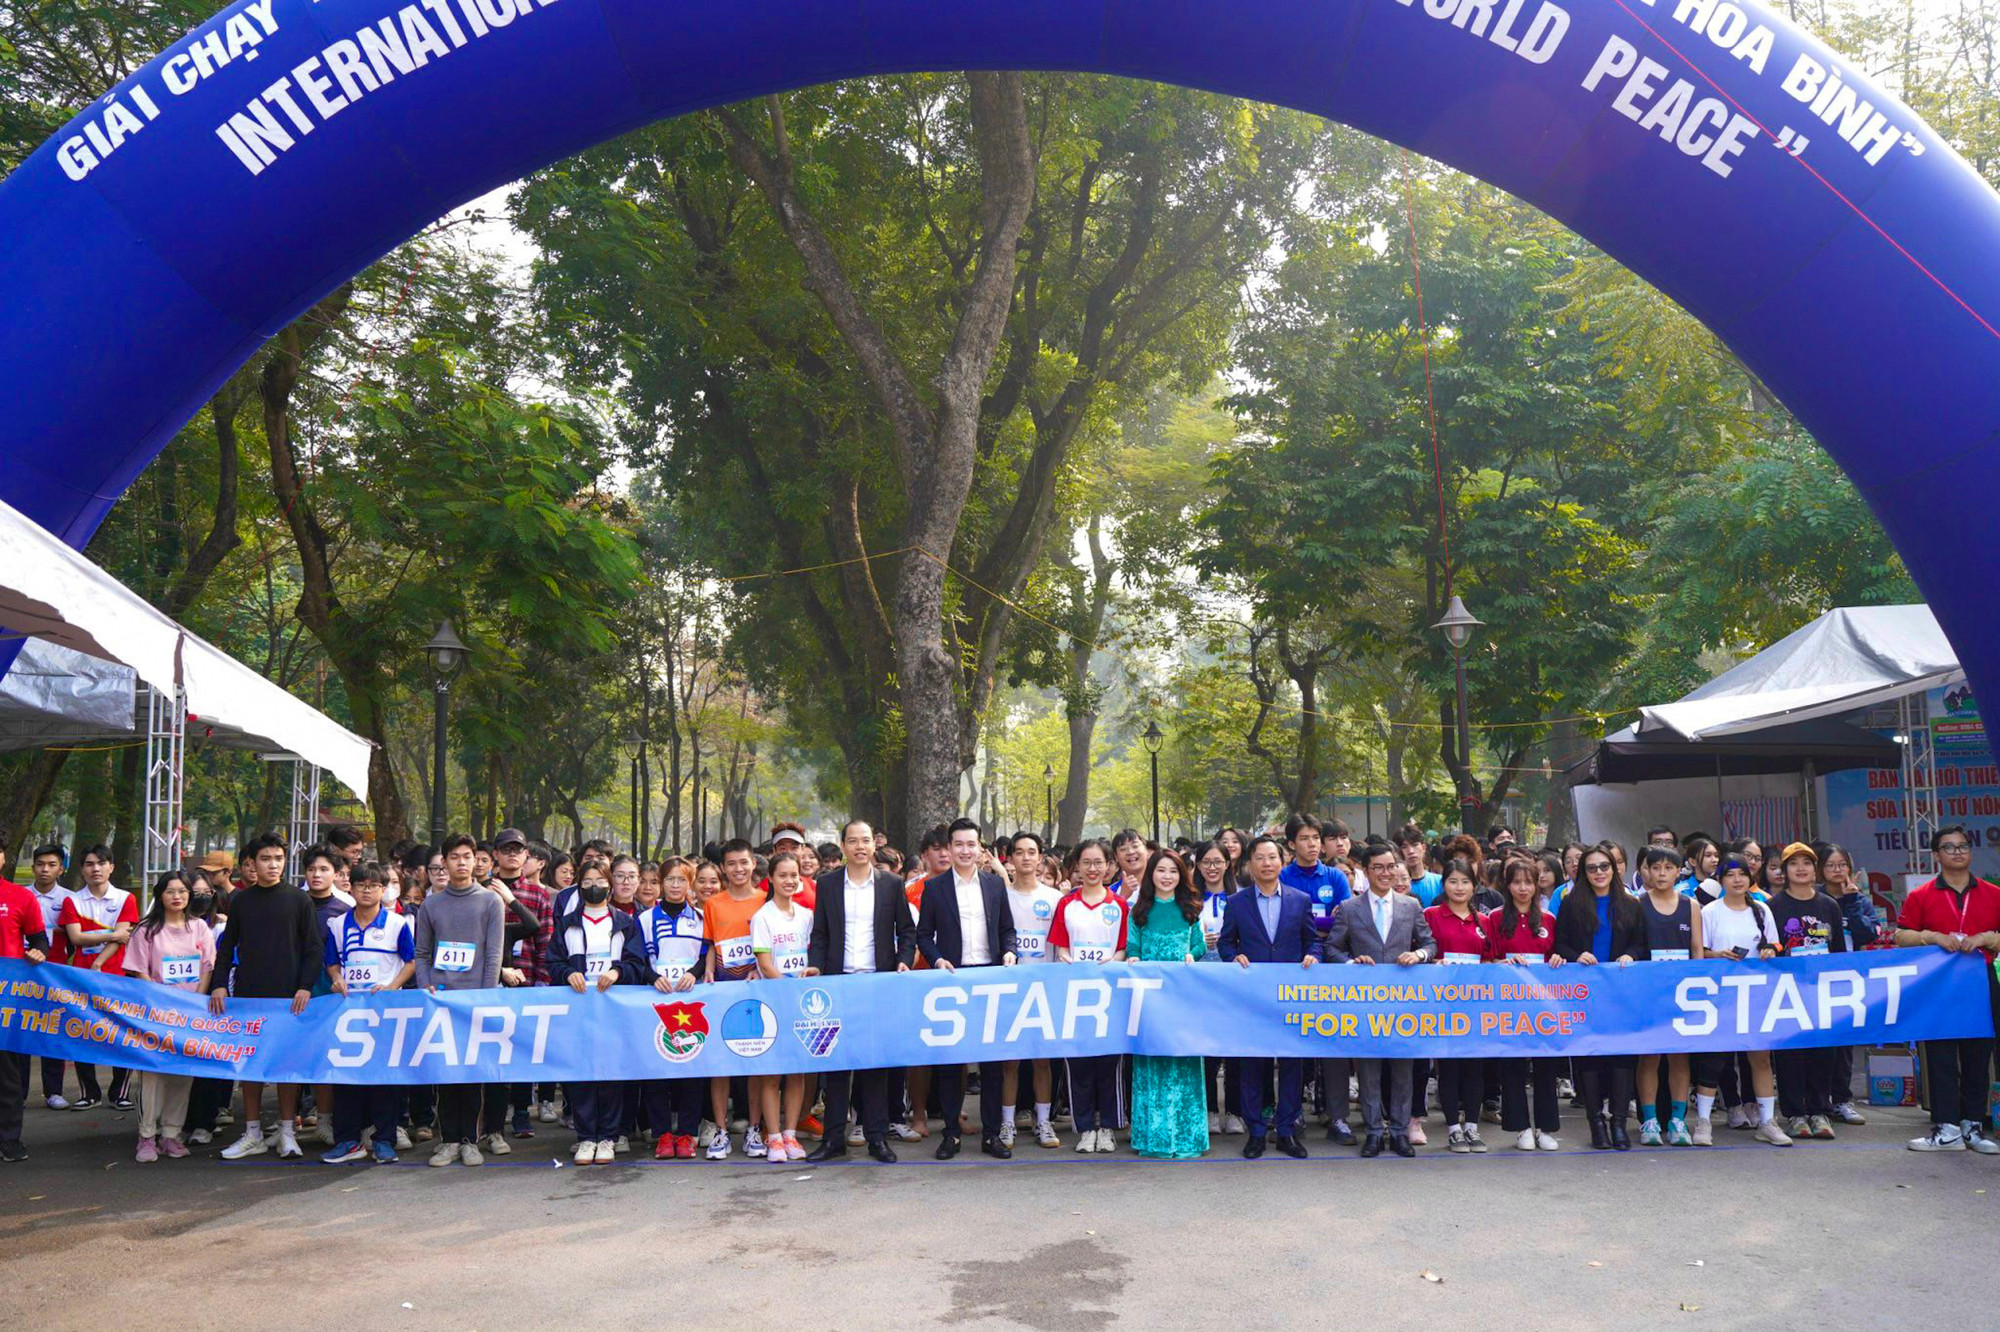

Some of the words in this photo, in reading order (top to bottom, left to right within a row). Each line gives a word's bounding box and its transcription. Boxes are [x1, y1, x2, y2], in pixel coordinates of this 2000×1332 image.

[55, 84, 161, 182] GIẢI
[160, 0, 280, 95] CHẠY
[1580, 34, 1760, 179] PEACE
[442, 951, 466, 963] 611
[728, 944, 752, 958] 490
[783, 957, 804, 969] 494
[1079, 950, 1103, 961] 342
[168, 962, 193, 975] 514
[349, 969, 371, 980] 286
[1277, 984, 1428, 1002] INTERNATIONAL
[1431, 984, 1494, 1001] YOUTH
[1500, 983, 1589, 1000] RUNNING
[1672, 964, 1918, 1037] START
[10, 980, 45, 999] HỮU
[91, 994, 147, 1019] THANH
[147, 1007, 188, 1028] NIÊN
[190, 1015, 242, 1034] QUỐC
[245, 1016, 267, 1035] TẾ
[919, 977, 1163, 1047] START
[20, 1007, 66, 1035] THẾ
[65, 1016, 119, 1044] GIỚI
[326, 1004, 569, 1067] START
[1284, 1012, 1360, 1037] “FOR
[1368, 1012, 1471, 1037] WORLD
[1480, 1011, 1586, 1037] PEACE”
